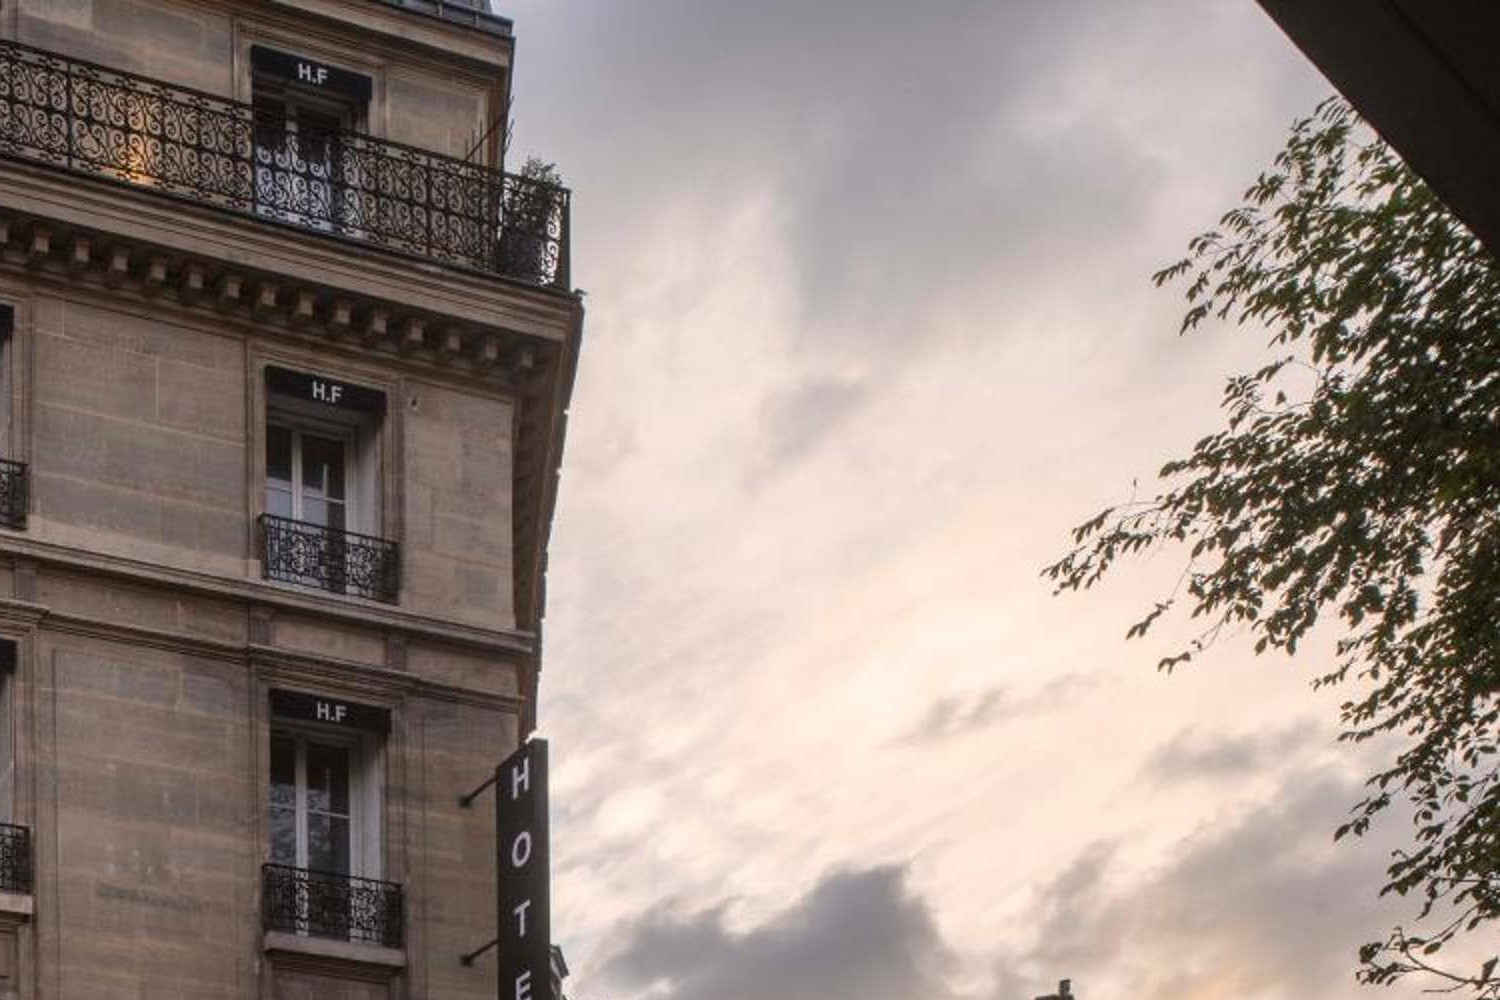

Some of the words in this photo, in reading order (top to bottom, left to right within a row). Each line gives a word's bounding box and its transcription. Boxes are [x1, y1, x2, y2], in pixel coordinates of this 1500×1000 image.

[299, 64, 327, 84] H.F
[313, 381, 342, 402] H.F
[317, 702, 346, 721] H.F
